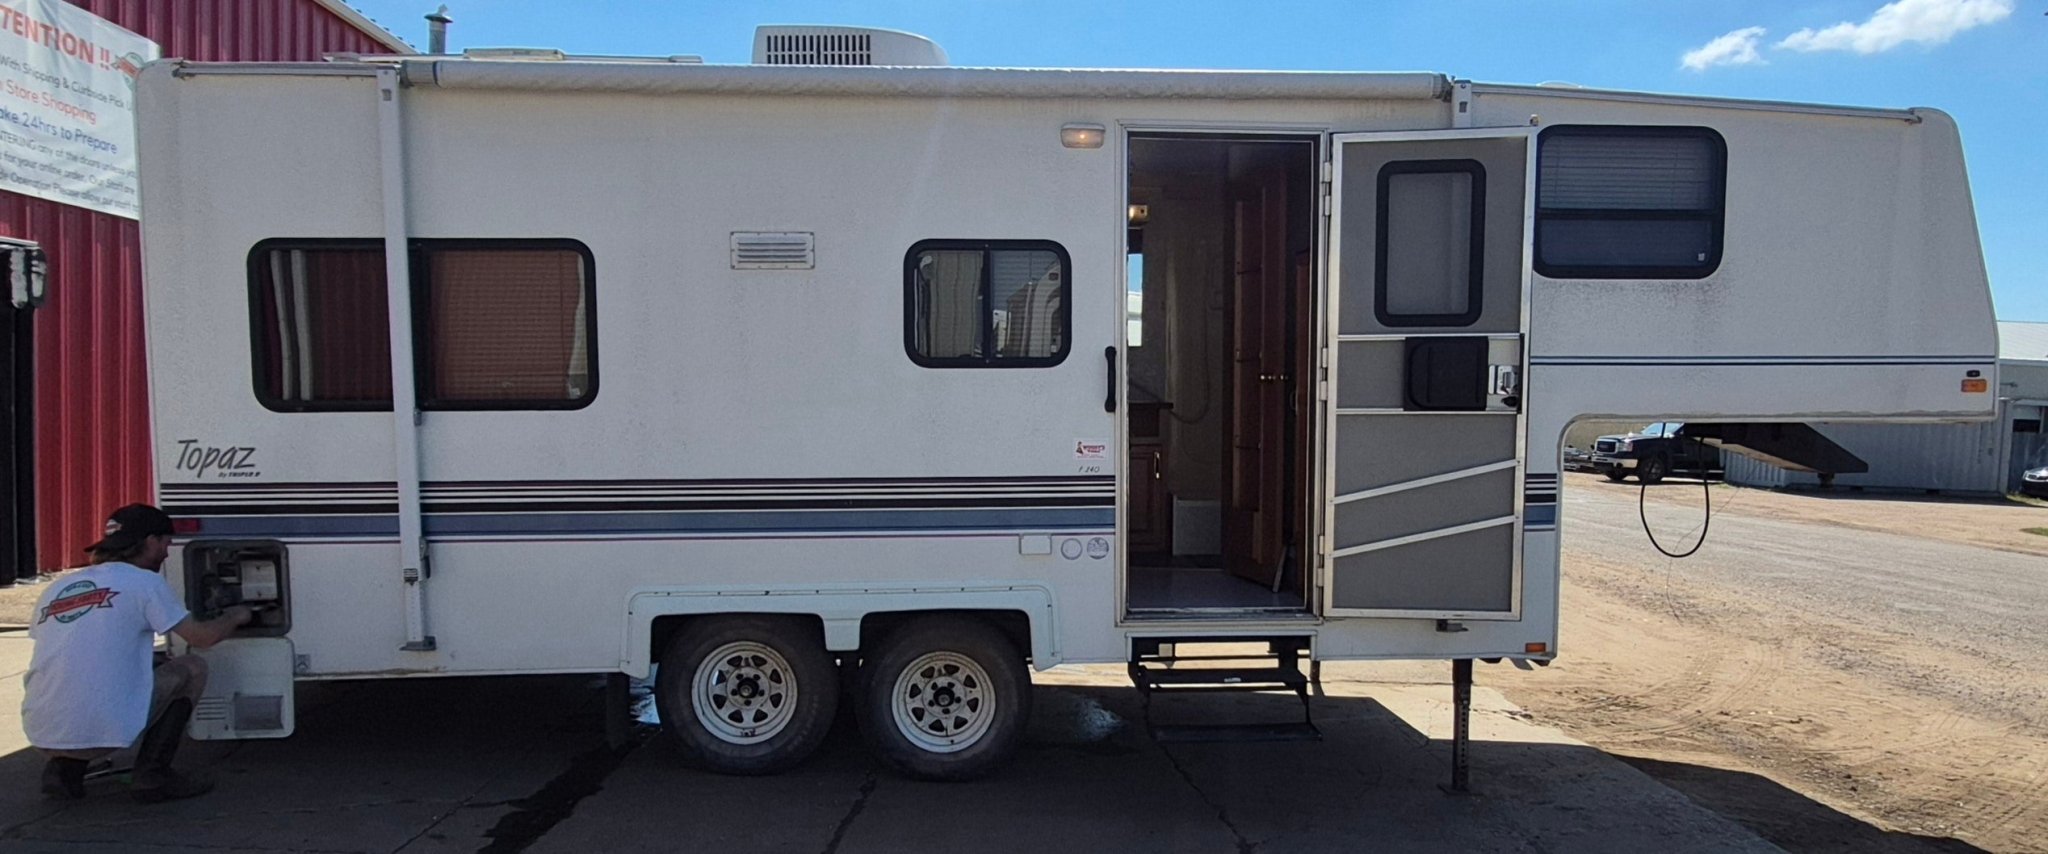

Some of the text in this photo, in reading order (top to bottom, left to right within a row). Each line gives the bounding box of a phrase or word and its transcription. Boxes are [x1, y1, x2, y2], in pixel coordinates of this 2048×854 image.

[22, 62, 60, 88] Shipping
[62, 77, 69, 89] &
[6, 79, 96, 125] Store Shopping
[22, 111, 57, 136] 24hrs
[60, 126, 72, 141] to
[75, 128, 118, 154] Prepare
[176, 438, 256, 478] Topaz
